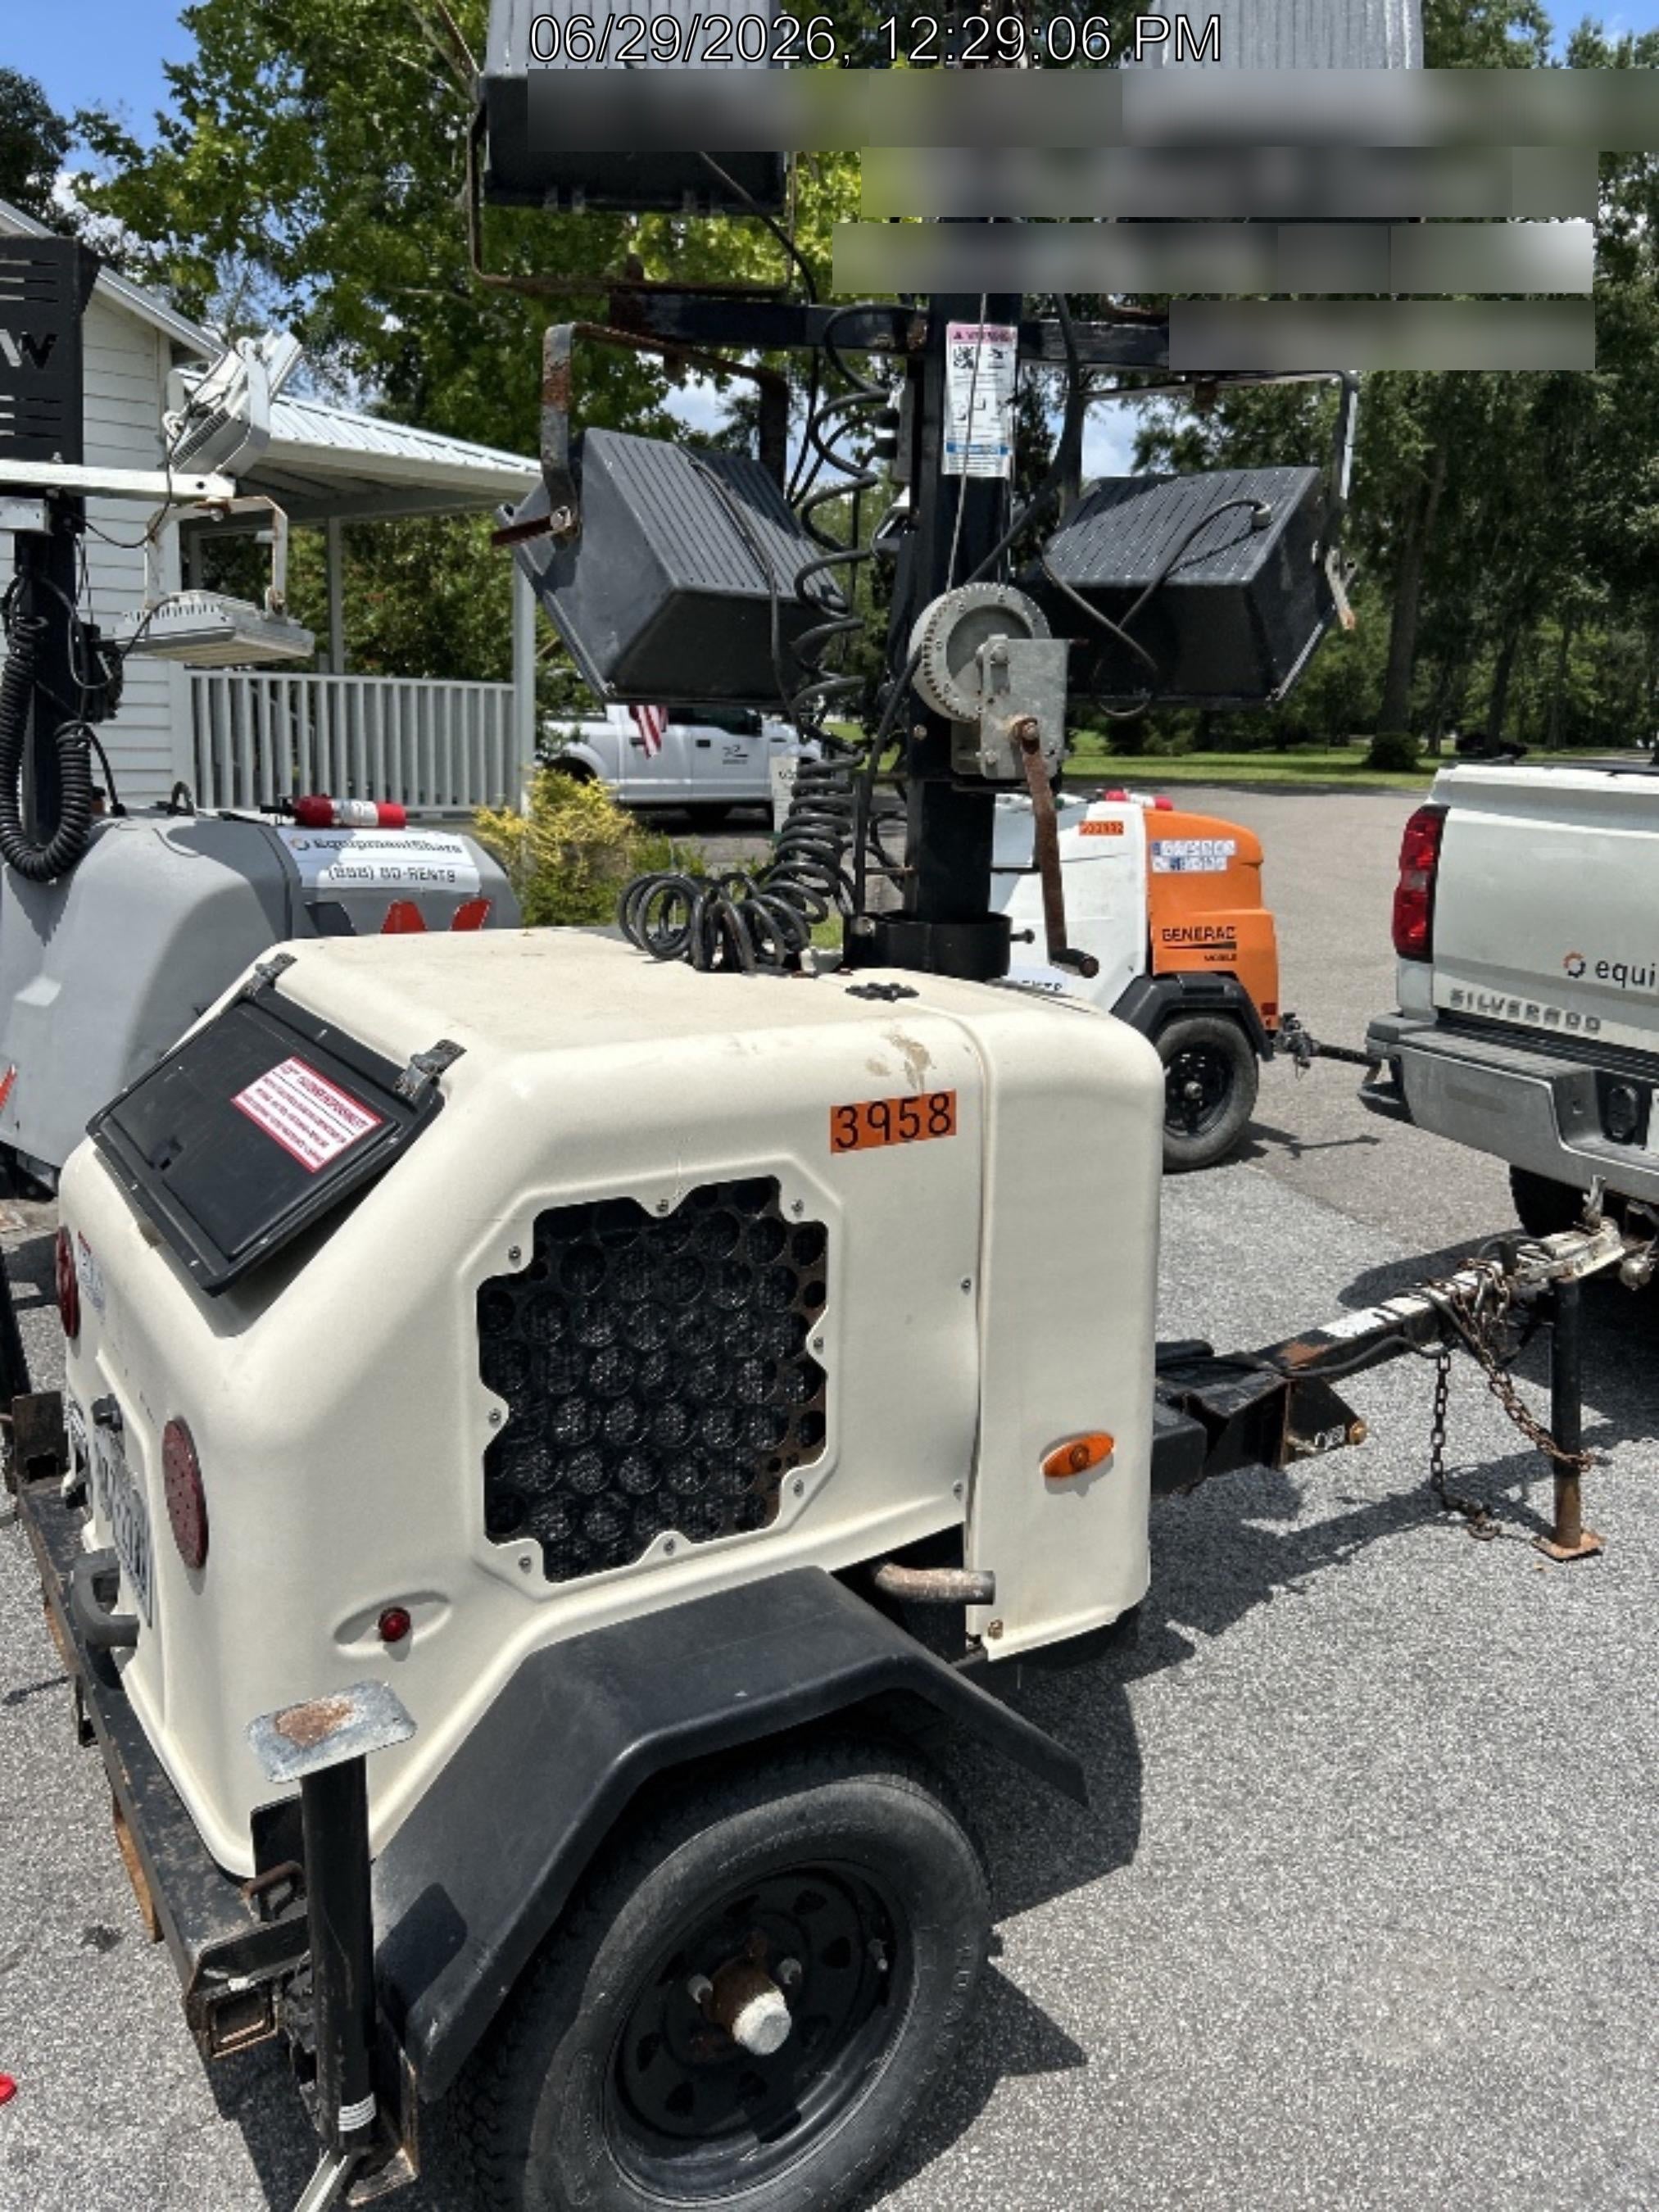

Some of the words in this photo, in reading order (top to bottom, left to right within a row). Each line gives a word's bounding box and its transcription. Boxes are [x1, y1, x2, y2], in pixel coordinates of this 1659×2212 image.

[1162, 926, 1236, 942] GENERAC
[1449, 986, 1602, 1036] SILVERADO
[835, 1093, 952, 1149] 3958
